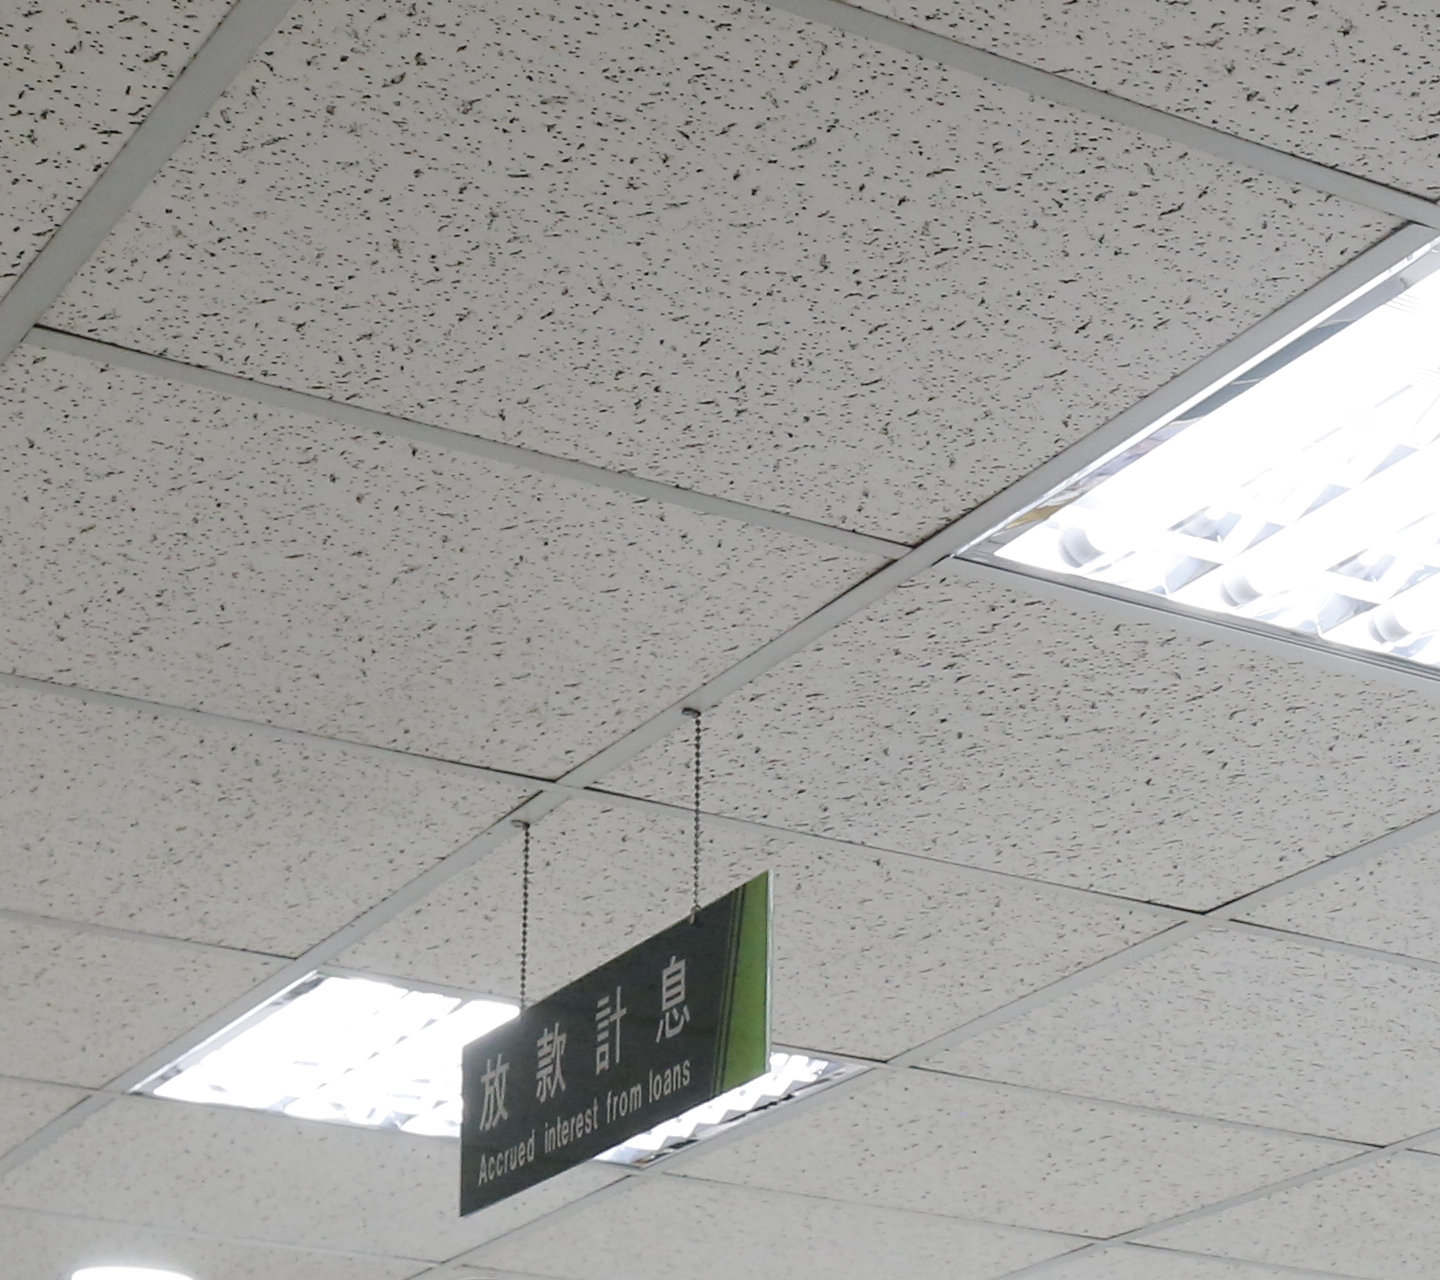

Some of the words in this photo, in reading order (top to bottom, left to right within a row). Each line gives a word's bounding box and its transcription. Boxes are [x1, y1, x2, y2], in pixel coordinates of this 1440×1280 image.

[478, 955, 691, 1131] 放款計息
[478, 1129, 535, 1186] Accrued
[543, 1097, 599, 1153] interest
[607, 1082, 642, 1124] from
[649, 1059, 691, 1105] loans
